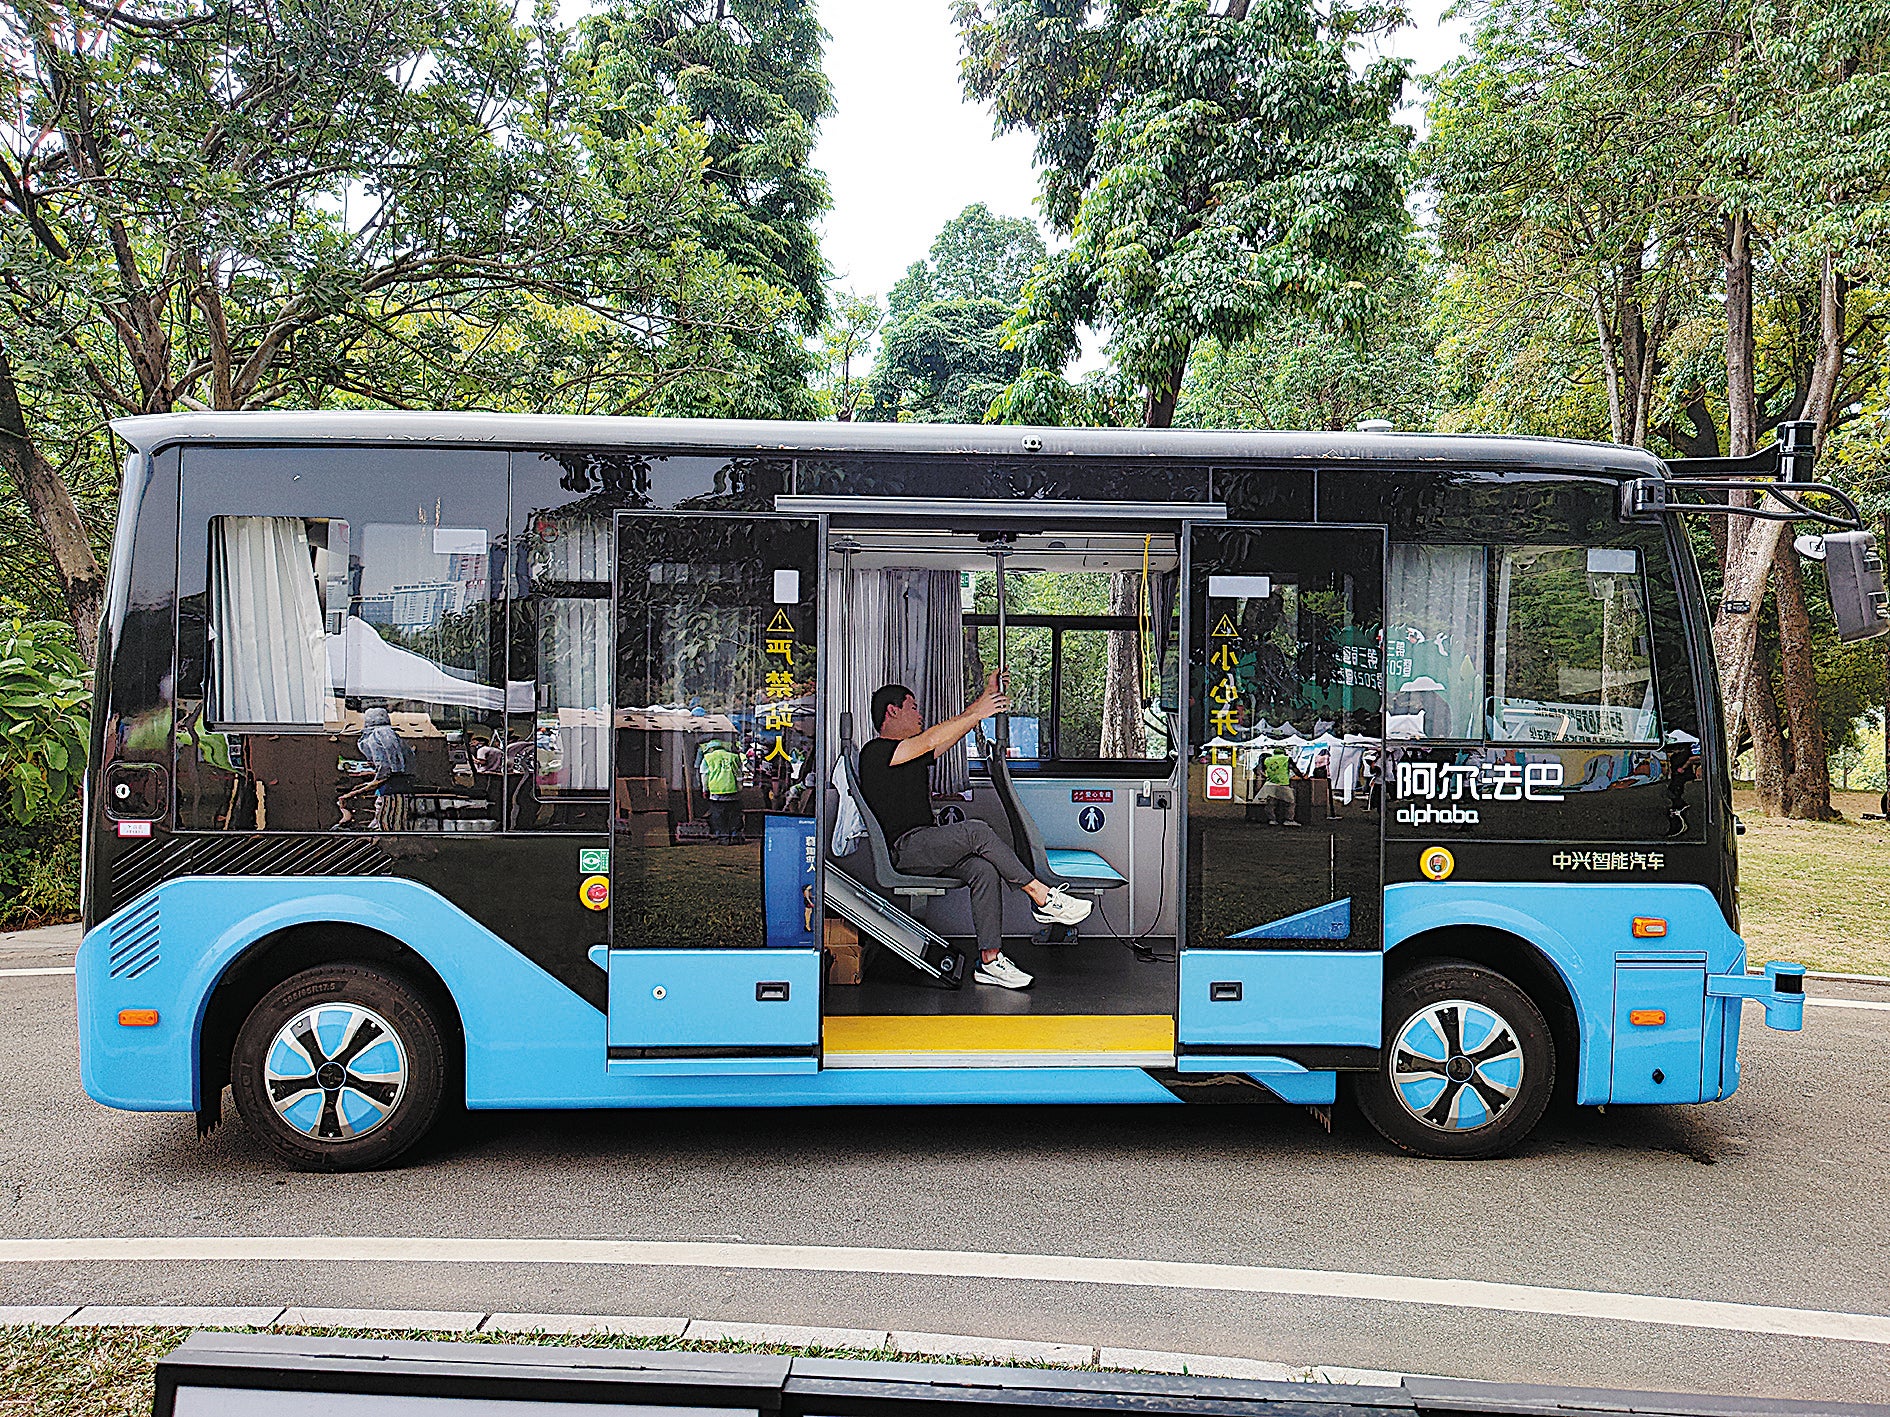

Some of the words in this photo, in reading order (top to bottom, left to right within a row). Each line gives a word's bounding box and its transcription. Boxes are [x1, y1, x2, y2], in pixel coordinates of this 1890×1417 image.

[1396, 761, 1565, 801] 阿尔法巴
[1396, 803, 1480, 827] alphaba
[1552, 850, 1665, 871] 中兴智能汽车
